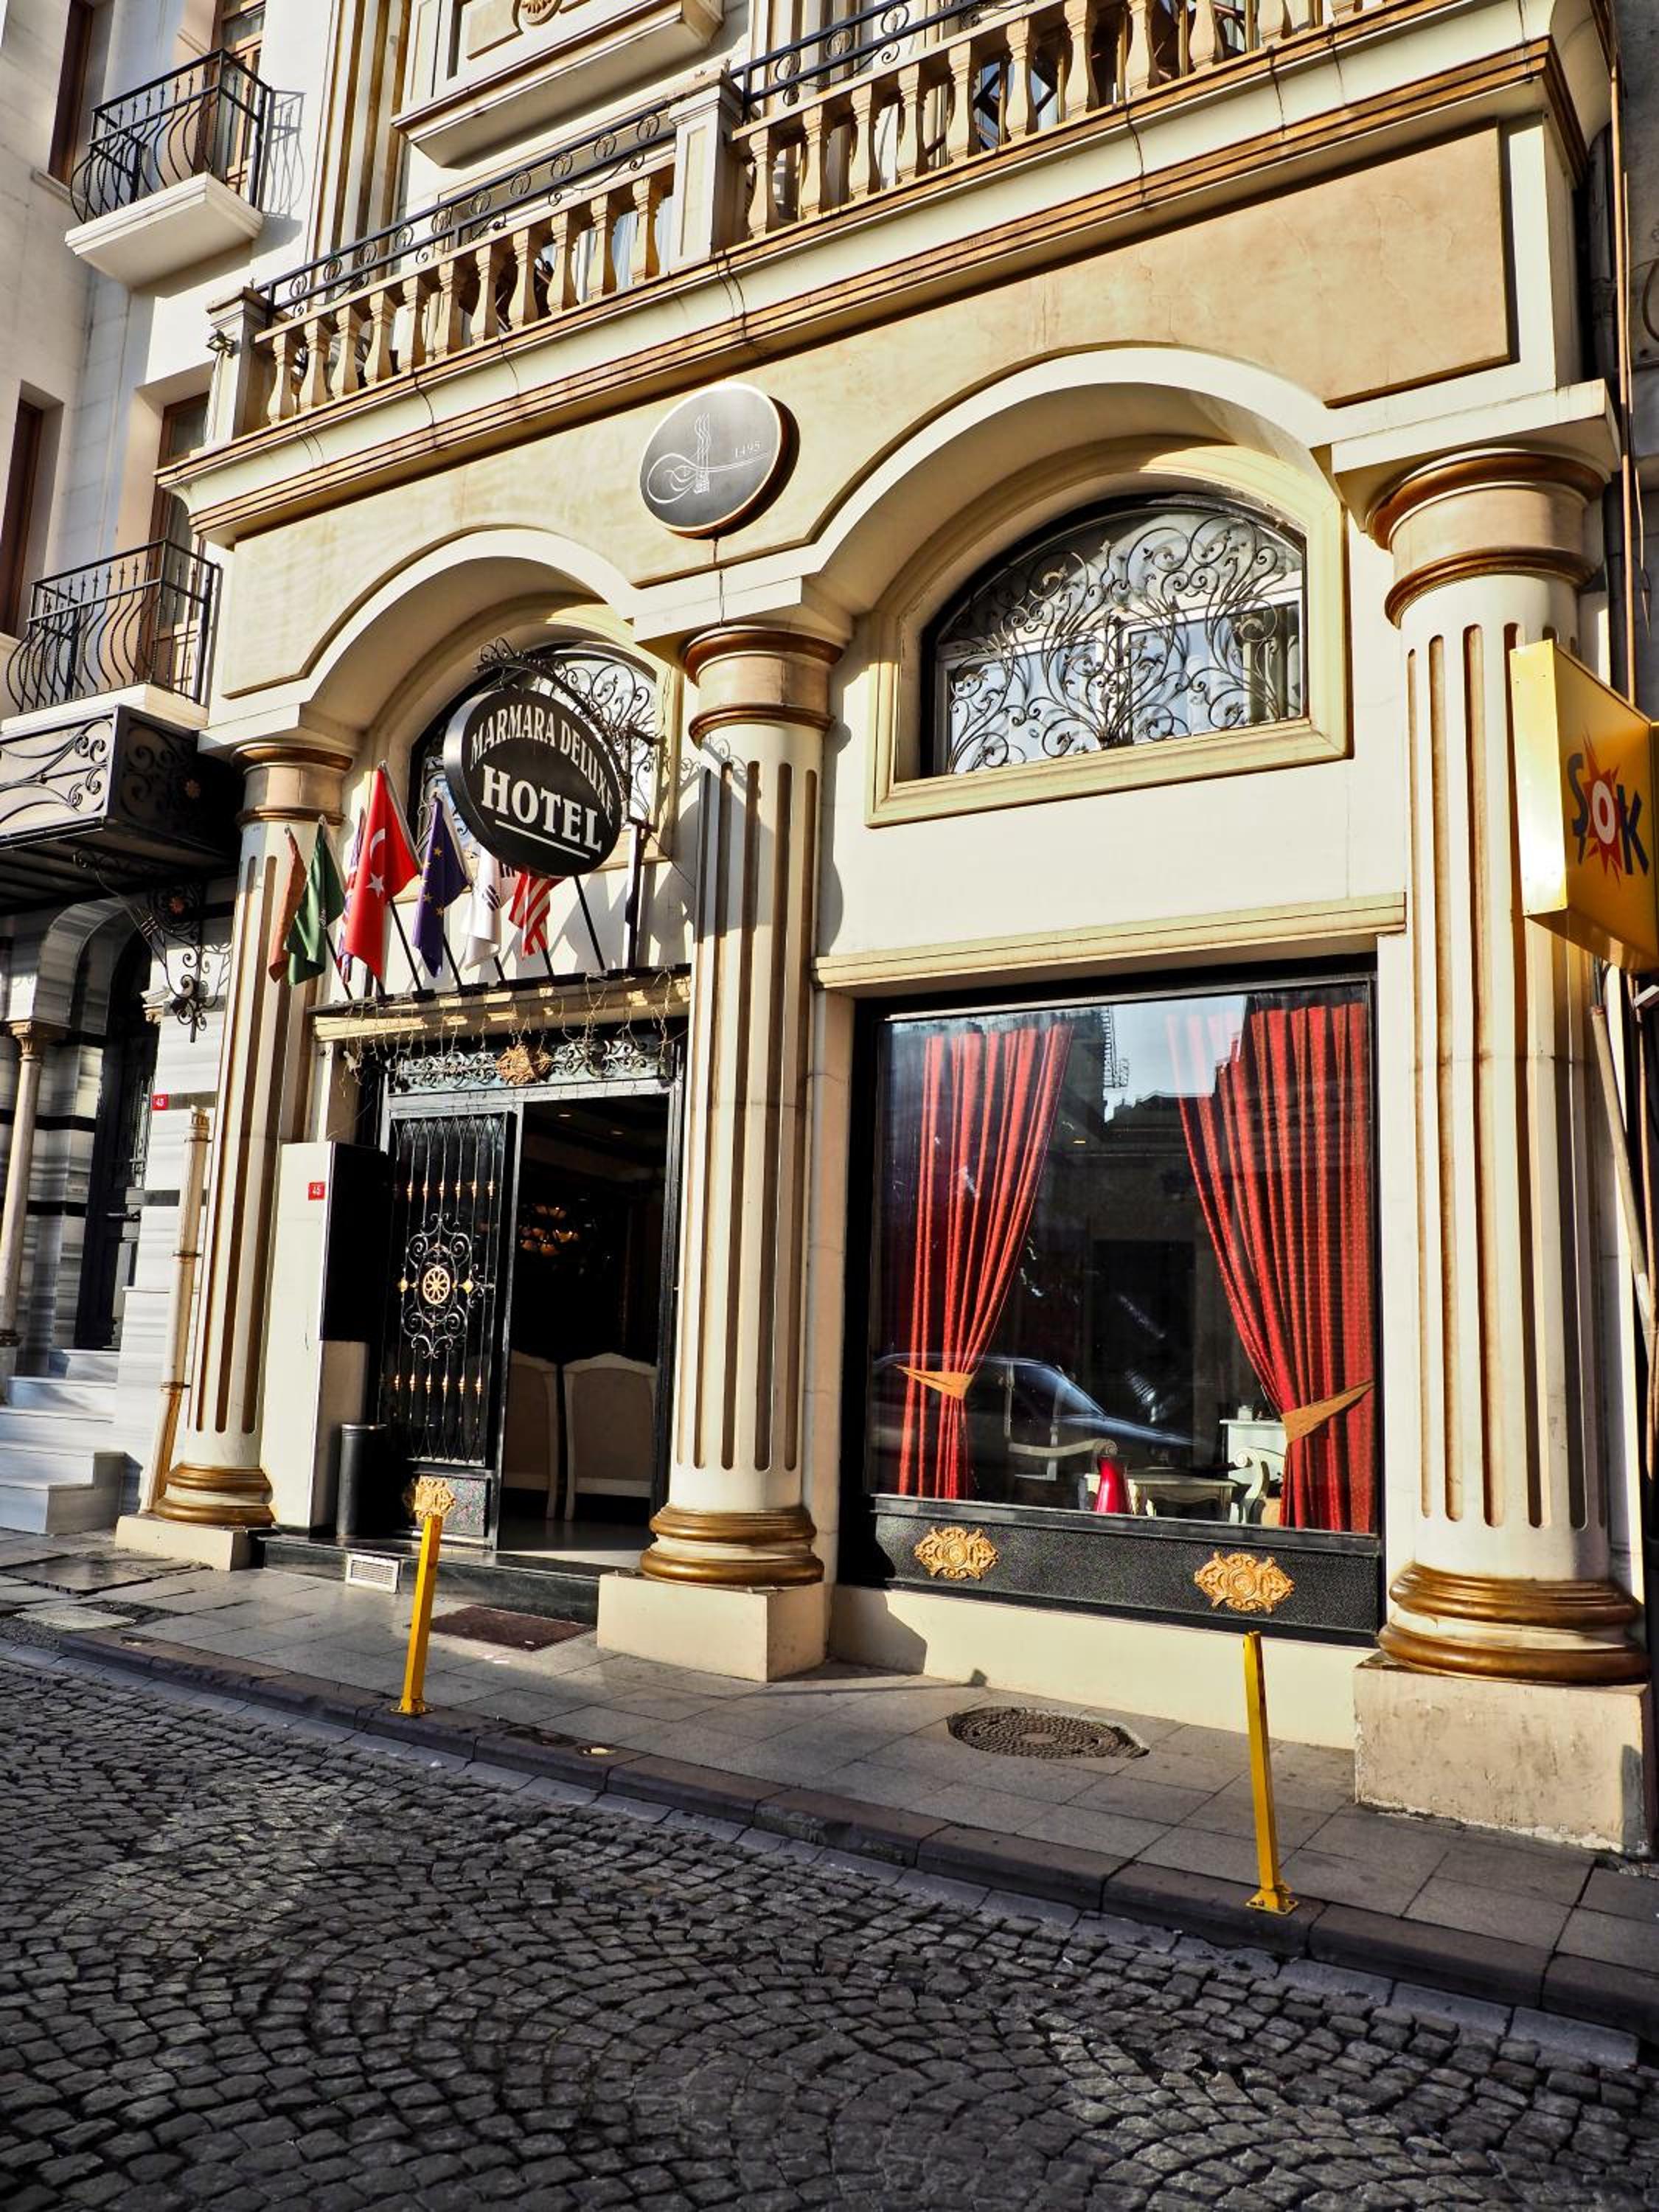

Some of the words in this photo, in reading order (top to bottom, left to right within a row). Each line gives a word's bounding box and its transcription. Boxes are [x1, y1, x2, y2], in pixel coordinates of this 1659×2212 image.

[470, 704, 555, 771] MARMARA
[560, 719, 613, 828] DELUXE
[481, 764, 602, 853] HOTEL
[1567, 752, 1649, 876] ŞOK
